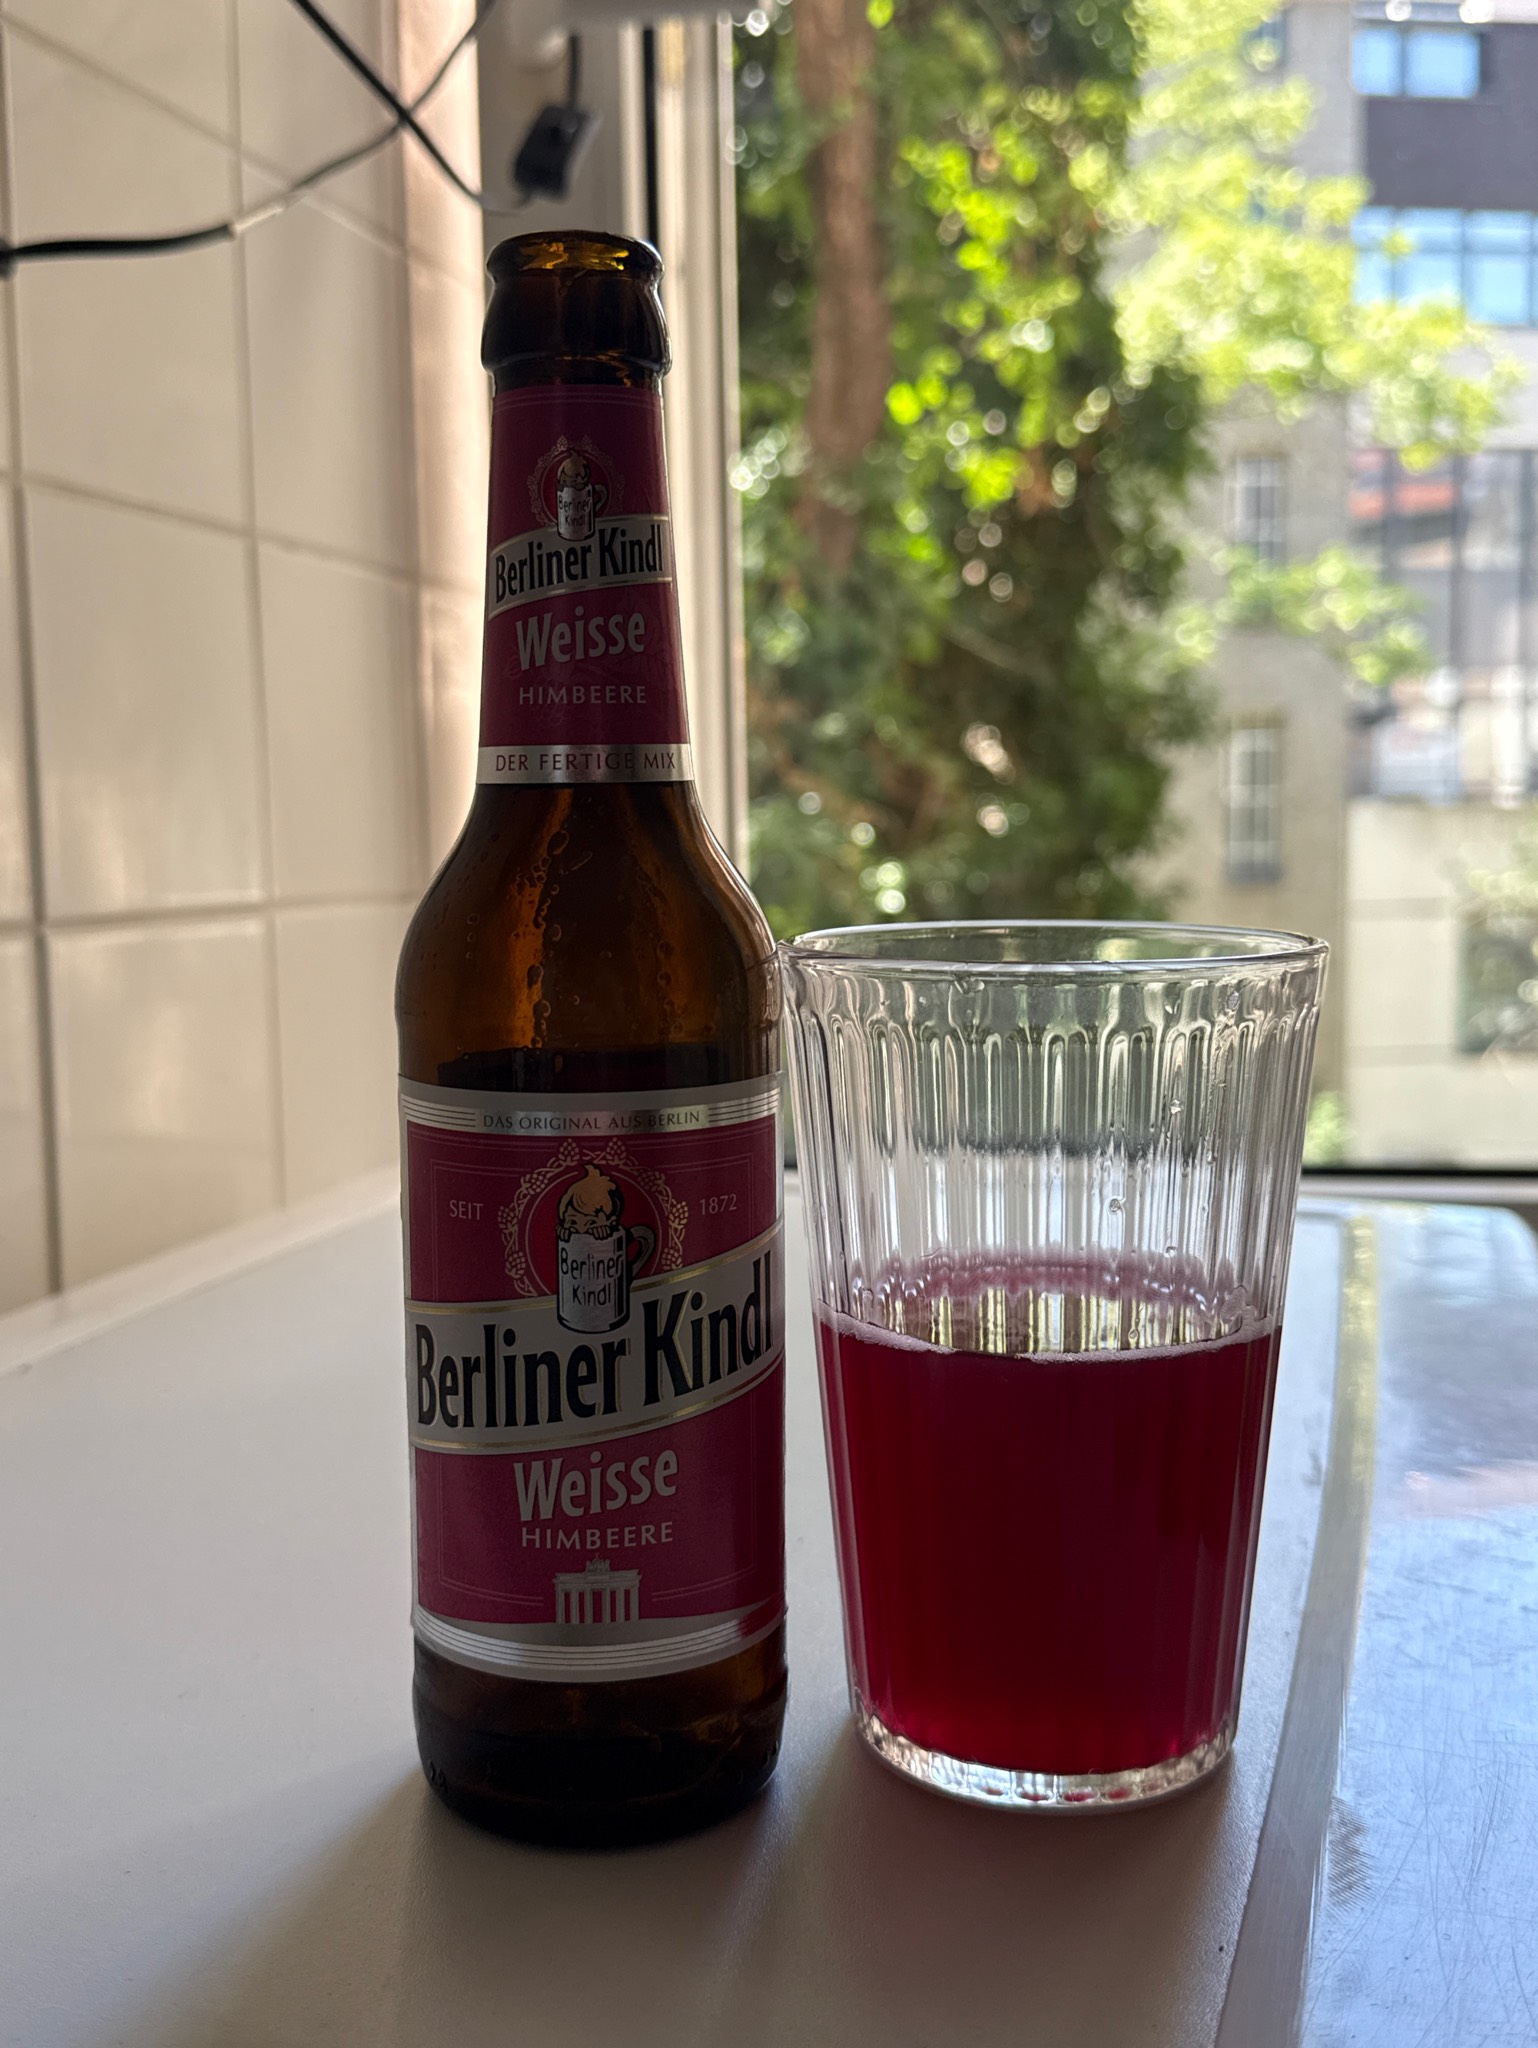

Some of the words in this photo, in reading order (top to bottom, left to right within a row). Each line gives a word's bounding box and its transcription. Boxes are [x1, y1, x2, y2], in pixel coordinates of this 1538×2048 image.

[495, 541, 592, 604] Berliner
[598, 523, 665, 578] Kindl
[515, 605, 646, 671] Weisse
[519, 685, 647, 705] HIMBEERE
[495, 754, 529, 772] DER
[539, 752, 634, 771] FERTIGE
[643, 751, 676, 770] MIX
[483, 1114, 514, 1129] DAS
[519, 1115, 602, 1131] ORIGINAL
[607, 1114, 642, 1130] AUS
[648, 1109, 700, 1127] BERLIN
[449, 1199, 484, 1221] SEIT
[700, 1193, 738, 1217] 1872
[560, 1246, 624, 1280] Berliner
[572, 1283, 613, 1307] Kindl
[416, 1323, 631, 1429] Berliner
[642, 1249, 774, 1406] Kindl
[513, 1449, 679, 1522] Weisse
[521, 1521, 674, 1550] HIMBEERE
